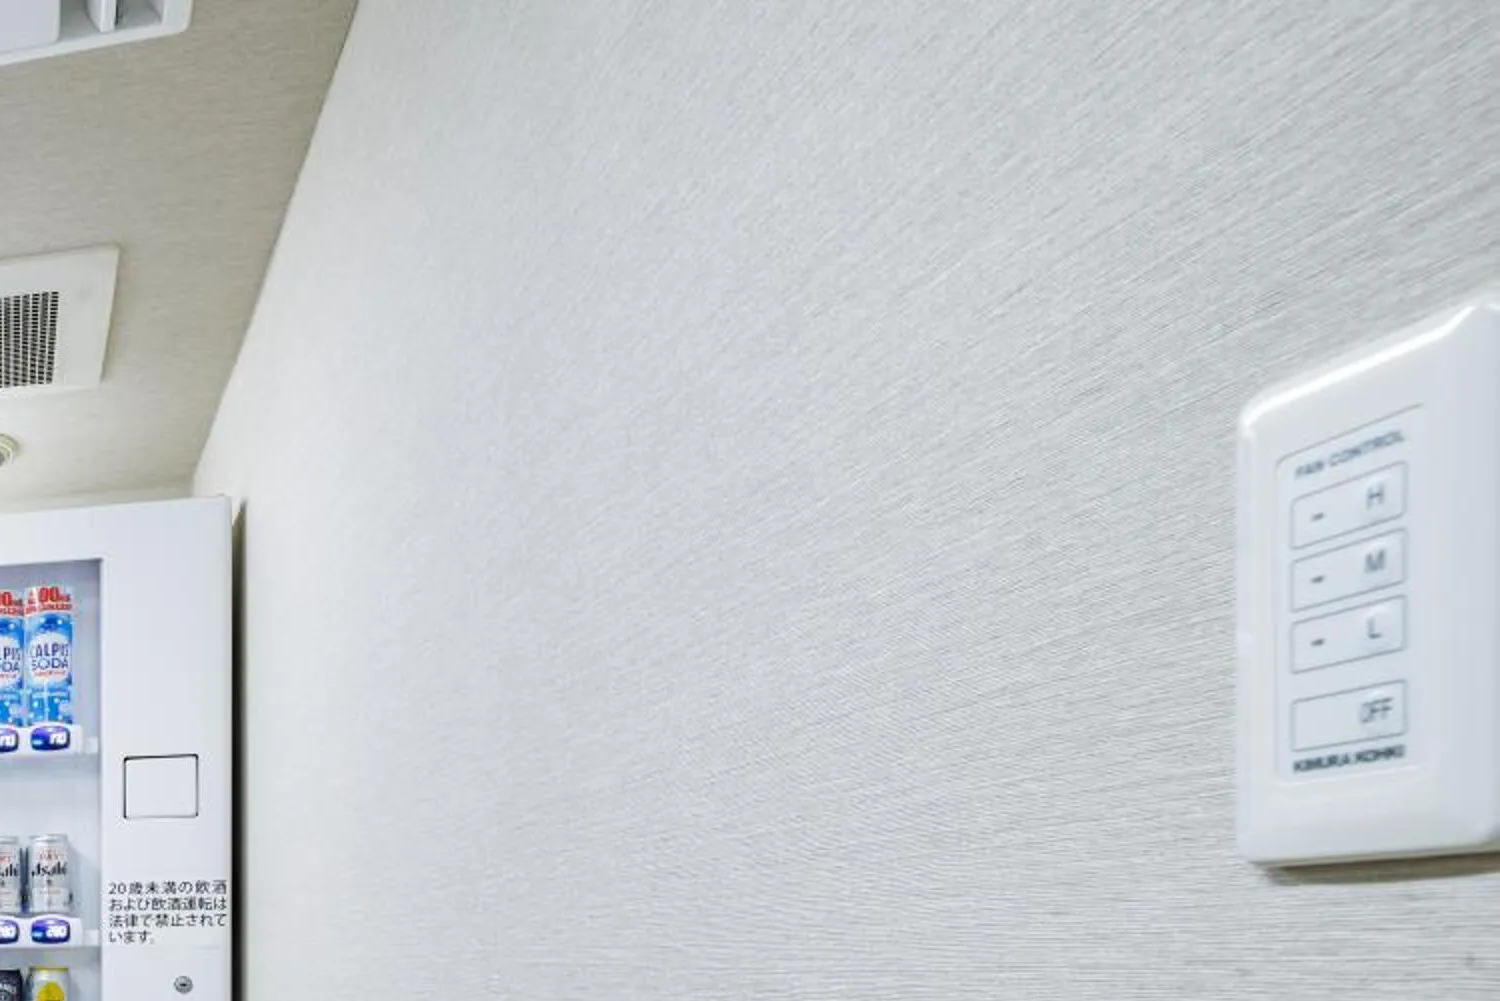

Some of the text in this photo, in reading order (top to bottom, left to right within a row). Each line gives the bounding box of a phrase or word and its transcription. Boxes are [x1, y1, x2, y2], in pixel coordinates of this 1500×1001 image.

[1330, 430, 1405, 467] CONTROL
[1366, 482, 1386, 510] H
[1365, 549, 1385, 573] M
[1367, 617, 1383, 640] L
[1360, 696, 1394, 724] OFF
[31, 861, 67, 877] Asahi
[108, 879, 227, 895] 20歳未満の飲酒
[108, 896, 228, 911] および飲酒運転は
[109, 913, 228, 928] 法律で禁止されて
